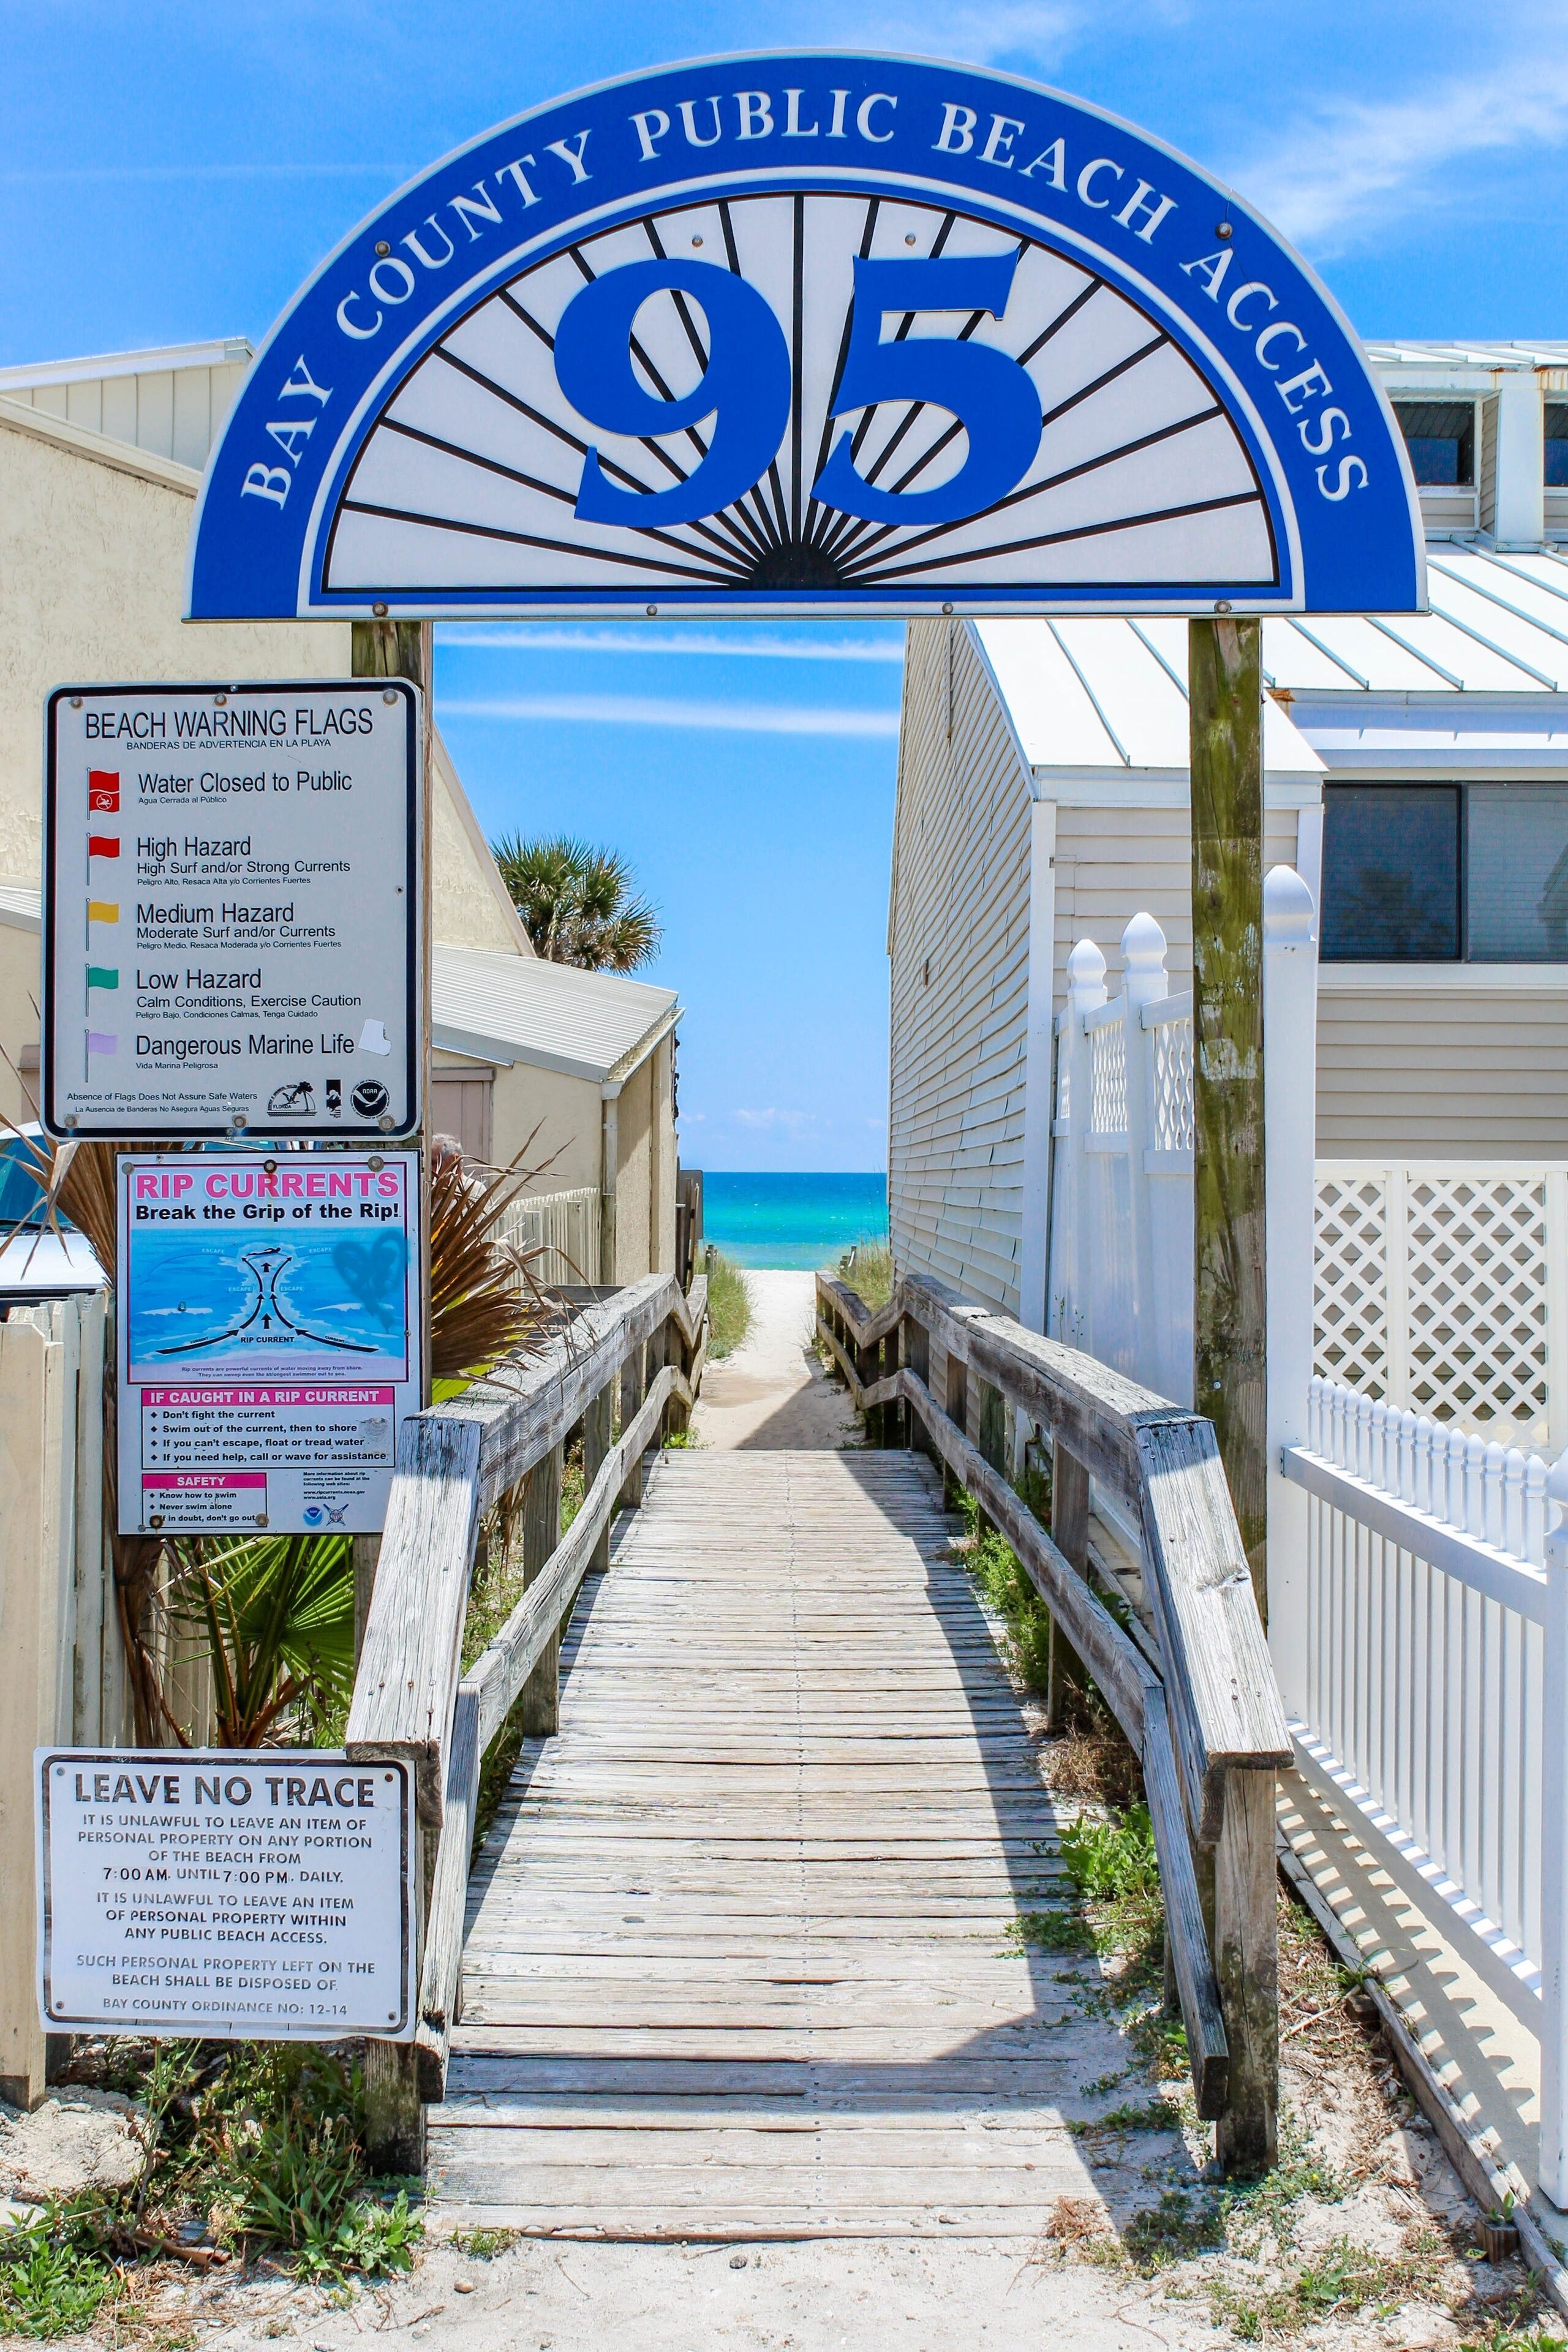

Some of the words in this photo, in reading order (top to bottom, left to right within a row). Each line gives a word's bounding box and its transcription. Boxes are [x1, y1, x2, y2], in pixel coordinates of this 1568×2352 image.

[240, 355, 333, 510] BAY
[336, 130, 592, 339] COUNTY
[630, 88, 898, 159] PUBLIC
[932, 102, 1178, 244] BEACH
[1180, 248, 1369, 502] ACCESS
[553, 247, 1042, 528] 95
[86, 712, 165, 739] BEACH
[174, 709, 286, 737] WARNING
[296, 708, 372, 735] FLAGS
[127, 741, 179, 750] BANDERAS
[198, 740, 267, 748] ADVERTENCIA
[138, 774, 194, 793] Water
[200, 772, 265, 793] Closed
[272, 772, 289, 791] to
[297, 771, 352, 791] Public
[137, 837, 176, 862] High
[185, 835, 251, 856] Hazard
[137, 862, 165, 876] High
[170, 862, 198, 873] Surf
[201, 861, 243, 873] and/or
[246, 861, 289, 875] Strong
[294, 861, 350, 872] Currents
[137, 903, 213, 923] Medium
[222, 902, 293, 922] Hazard
[137, 927, 198, 938] Moderate
[203, 926, 230, 938] Surf
[234, 926, 276, 937] and/or
[279, 925, 335, 937] Currents
[137, 969, 178, 989] Low
[187, 968, 261, 989] Hazard
[137, 996, 170, 1008] Calm
[175, 995, 245, 1008] Conditions,
[251, 995, 306, 1006] Exercise
[311, 995, 361, 1006] Caution
[137, 1035, 241, 1060] Dangerous
[249, 1034, 313, 1054] Marine
[321, 1033, 354, 1054] Life
[183, 1061, 218, 1070] Peligrosa
[115, 1093, 136, 1102] Flags
[137, 1174, 193, 1198] RIP
[206, 1172, 398, 1197] CURRENTS
[136, 1205, 196, 1219] Break
[202, 1204, 236, 1219] the
[243, 1204, 285, 1222] Grip
[292, 1204, 312, 1218] of
[319, 1204, 352, 1218] the
[360, 1203, 399, 1221] Rip!
[151, 1392, 164, 1403] IF
[169, 1392, 233, 1403] CAUGHT
[239, 1392, 254, 1402] IN
[259, 1392, 270, 1402] A
[275, 1391, 300, 1402] RIP
[305, 1390, 379, 1402] CURRENT
[191, 1411, 215, 1420] fight
[246, 1425, 286, 1433] current,
[289, 1424, 312, 1433] then
[222, 1453, 247, 1462] help,
[177, 1476, 225, 1486] SAFETY
[75, 1773, 179, 1804] LEAVE
[195, 1776, 251, 1806] NO
[265, 1777, 374, 1807] TRACE
[83, 1814, 95, 1824] IT
[101, 1815, 113, 1825] IS
[119, 1815, 200, 1827] UNLAWFUL
[205, 1817, 224, 1828] TO
[230, 1817, 274, 1828] LEAVE
[279, 1818, 301, 1829] AN
[307, 1819, 341, 1830] ITEM
[347, 1819, 366, 1830] OF
[78, 1831, 154, 1843] PERSONAL
[160, 1833, 233, 1845] PROPERTY
[238, 1834, 262, 1845] ON
[268, 1835, 299, 1846] ANY
[304, 1836, 371, 1848] PORTION
[149, 1850, 167, 1861] OF
[173, 1851, 199, 1861] THE
[206, 1852, 252, 1863] BEACH
[259, 1853, 301, 1864] FROM
[103, 1868, 141, 1880] 7:00
[177, 1868, 221, 1880] UNTIL
[223, 1871, 260, 1883] 7:00
[300, 1871, 343, 1883] DAILY.
[106, 1910, 124, 1920] OF
[130, 1910, 206, 1922] PERSONAL
[213, 1912, 285, 1924] PROPERTY
[290, 1914, 345, 1926] WITHIN
[124, 1928, 156, 1939] ANY
[161, 1928, 211, 1940] PUBLIC
[217, 1930, 264, 1942] BEACH
[270, 1931, 326, 1943] ACCESS.
[104, 1998, 127, 2008] BAY
[132, 1999, 187, 2010] COUNTY
[192, 2000, 272, 2012] ORDINANCE
[277, 2003, 303, 2013] NO:
[309, 2004, 347, 2015] 12-14
